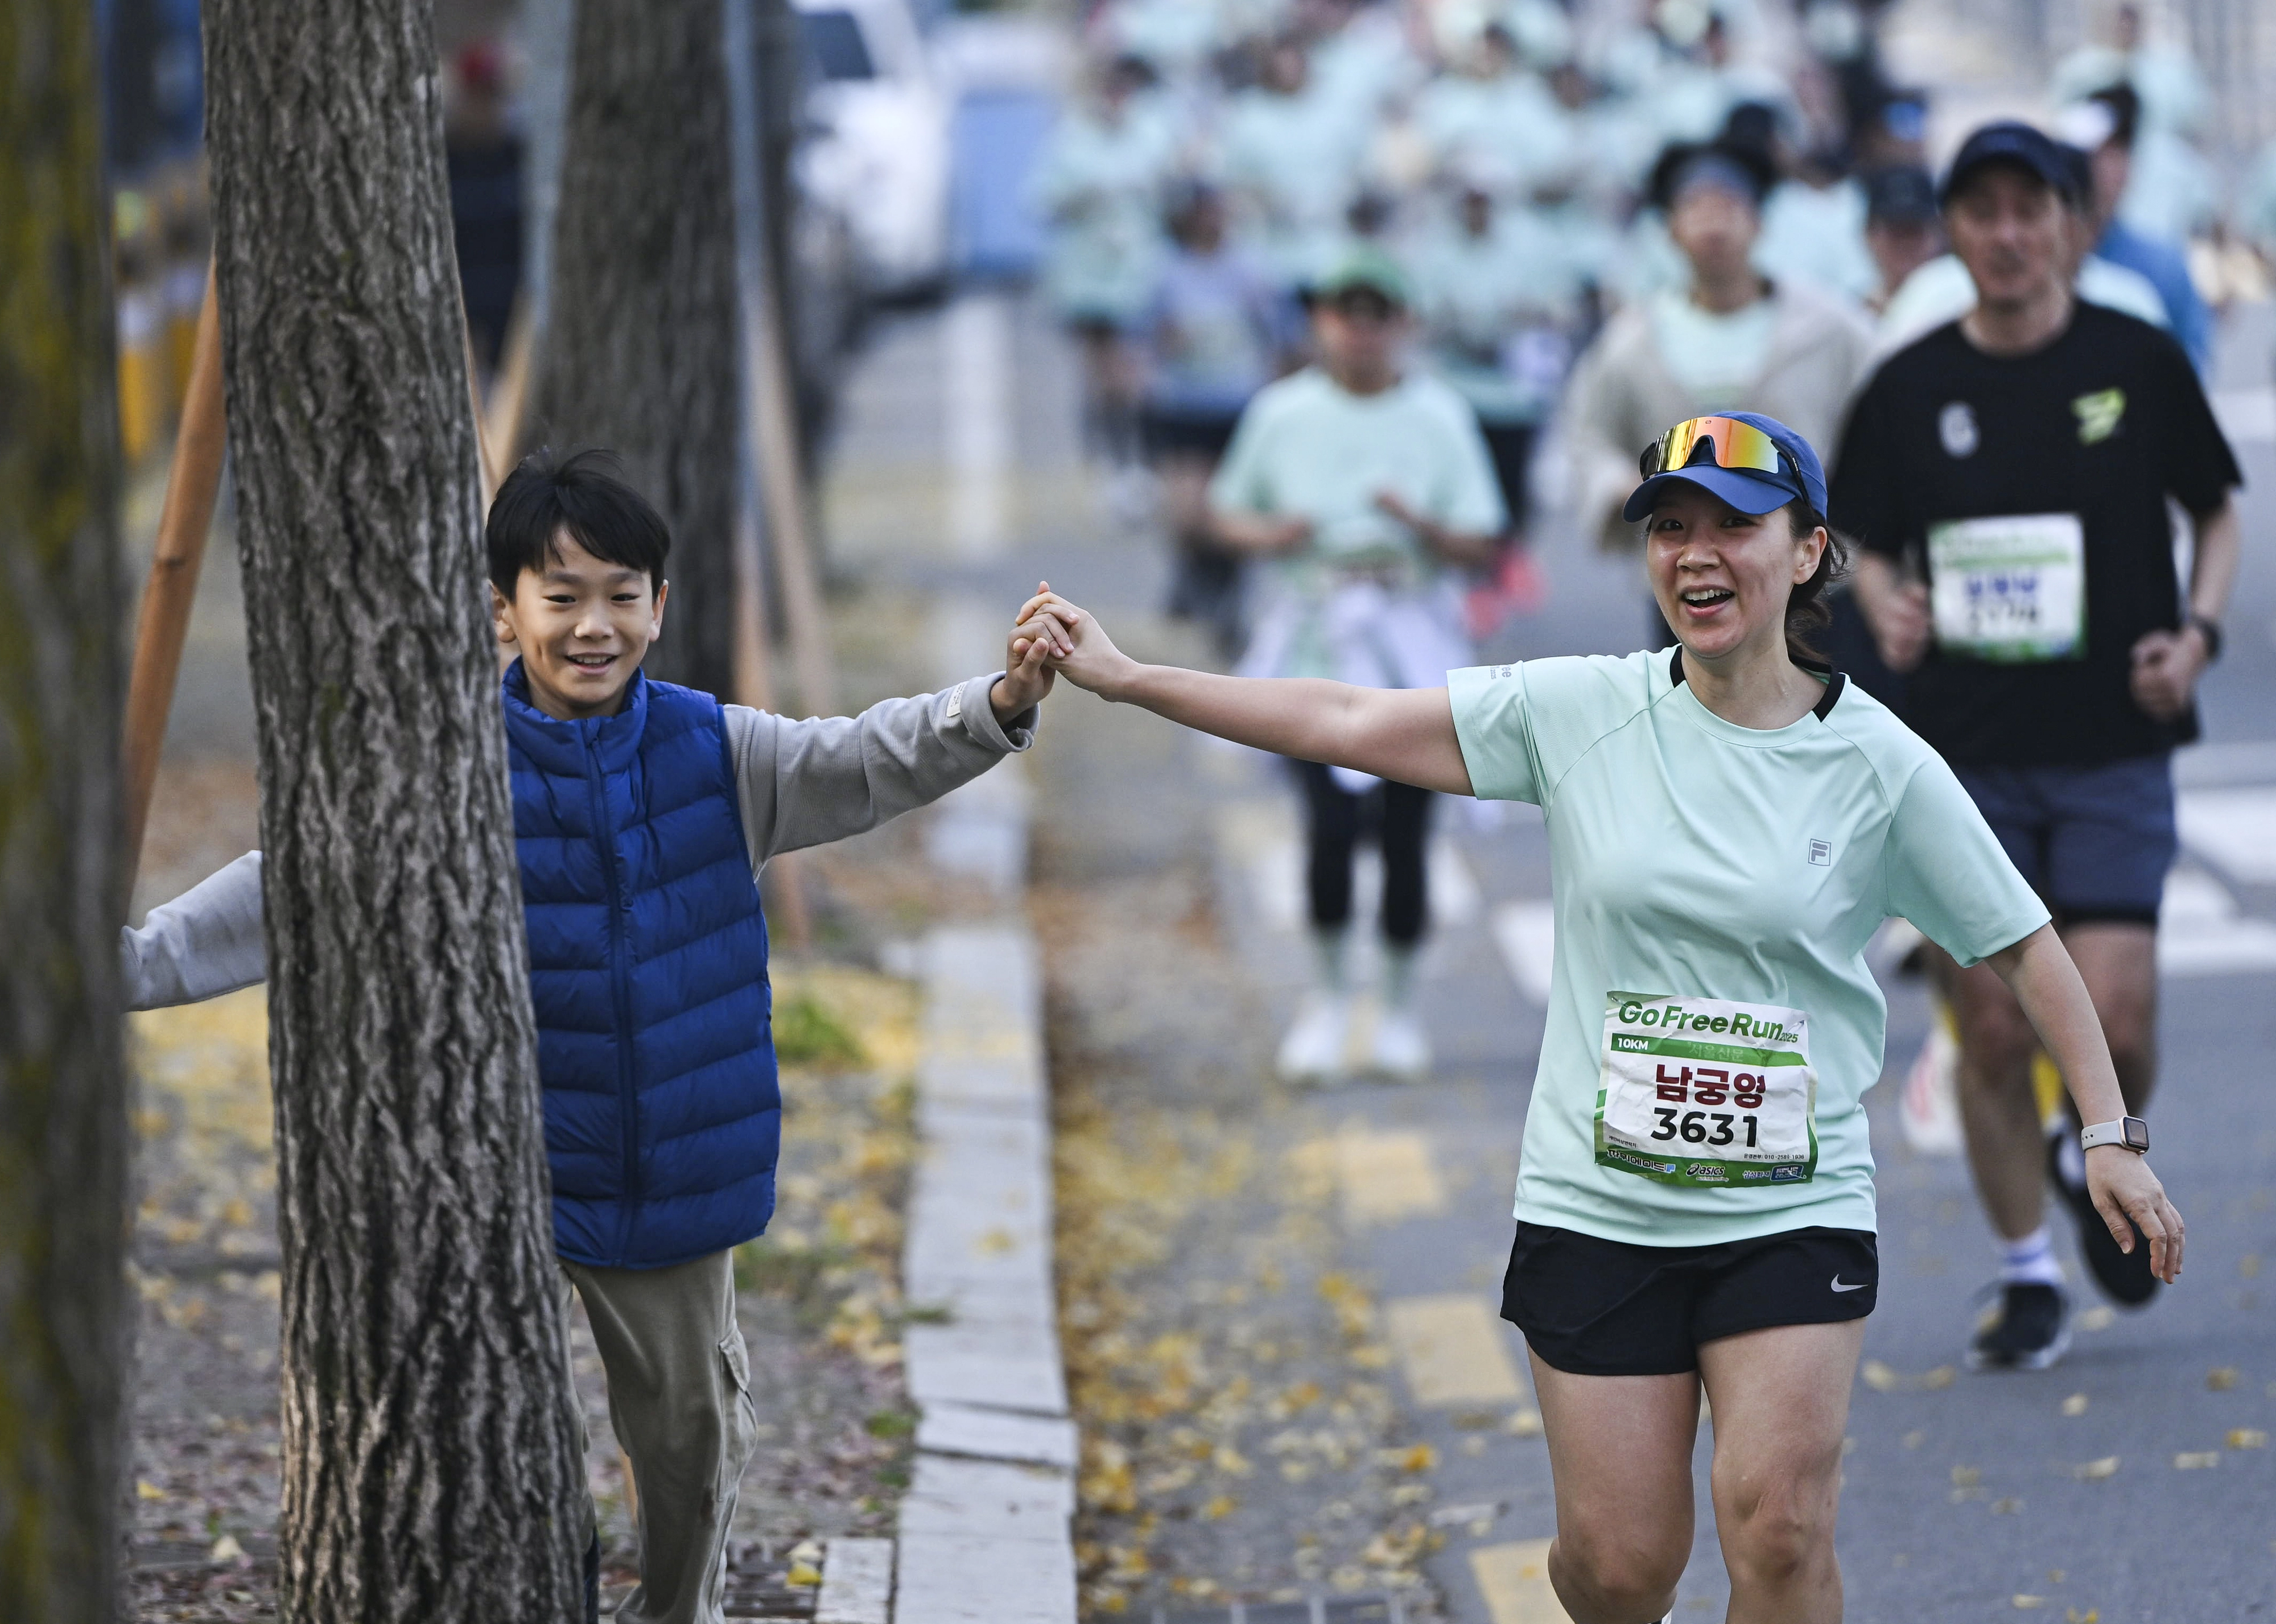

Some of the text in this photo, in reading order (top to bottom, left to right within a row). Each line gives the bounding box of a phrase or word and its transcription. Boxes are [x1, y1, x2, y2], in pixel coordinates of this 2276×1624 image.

[1618, 1037, 1649, 1050] 10KM
[1689, 1043, 1743, 1062] 서울신문
[1656, 1064, 1766, 1108] 남궁영
[1651, 1107, 1758, 1147] 3631
